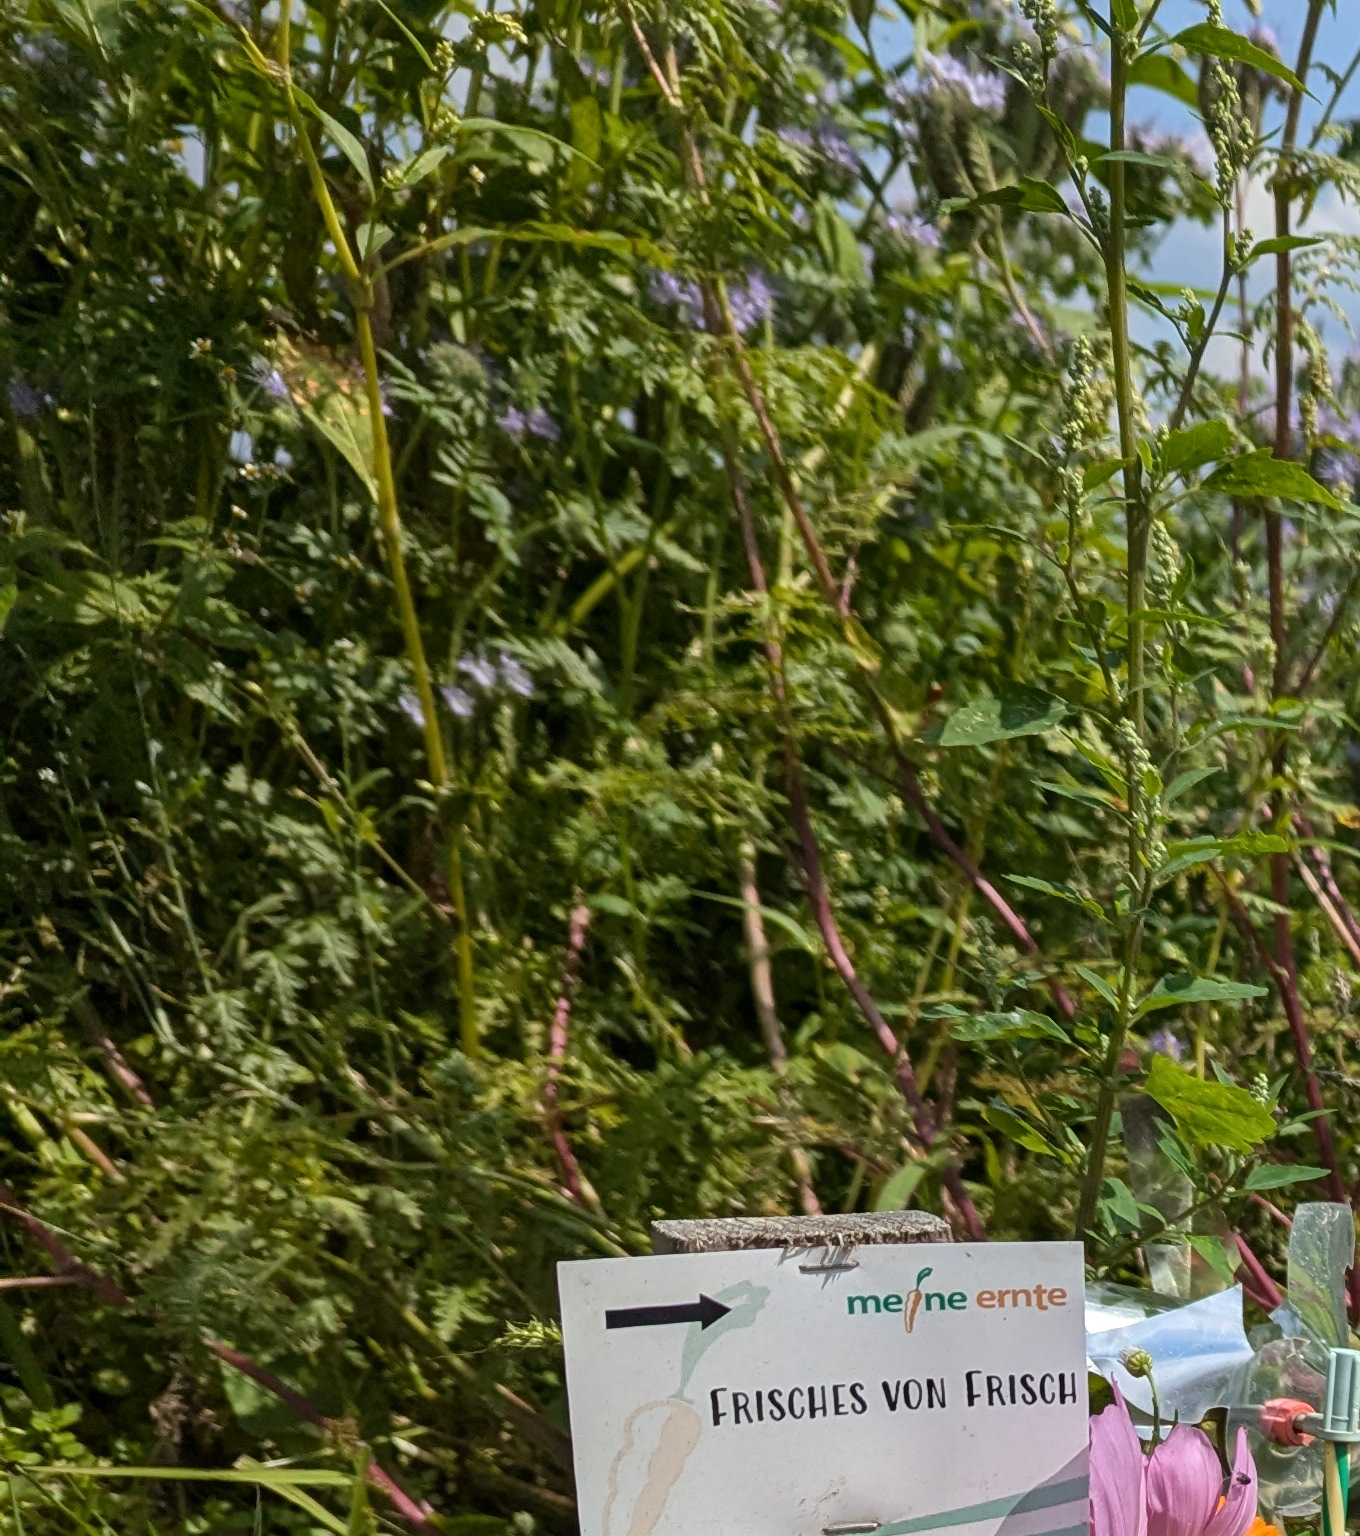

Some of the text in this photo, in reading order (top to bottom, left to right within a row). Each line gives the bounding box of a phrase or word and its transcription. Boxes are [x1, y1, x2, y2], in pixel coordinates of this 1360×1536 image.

[976, 1283, 1068, 1311] ernte
[709, 1370, 1077, 1426] FRISCHES VON FRISCH
